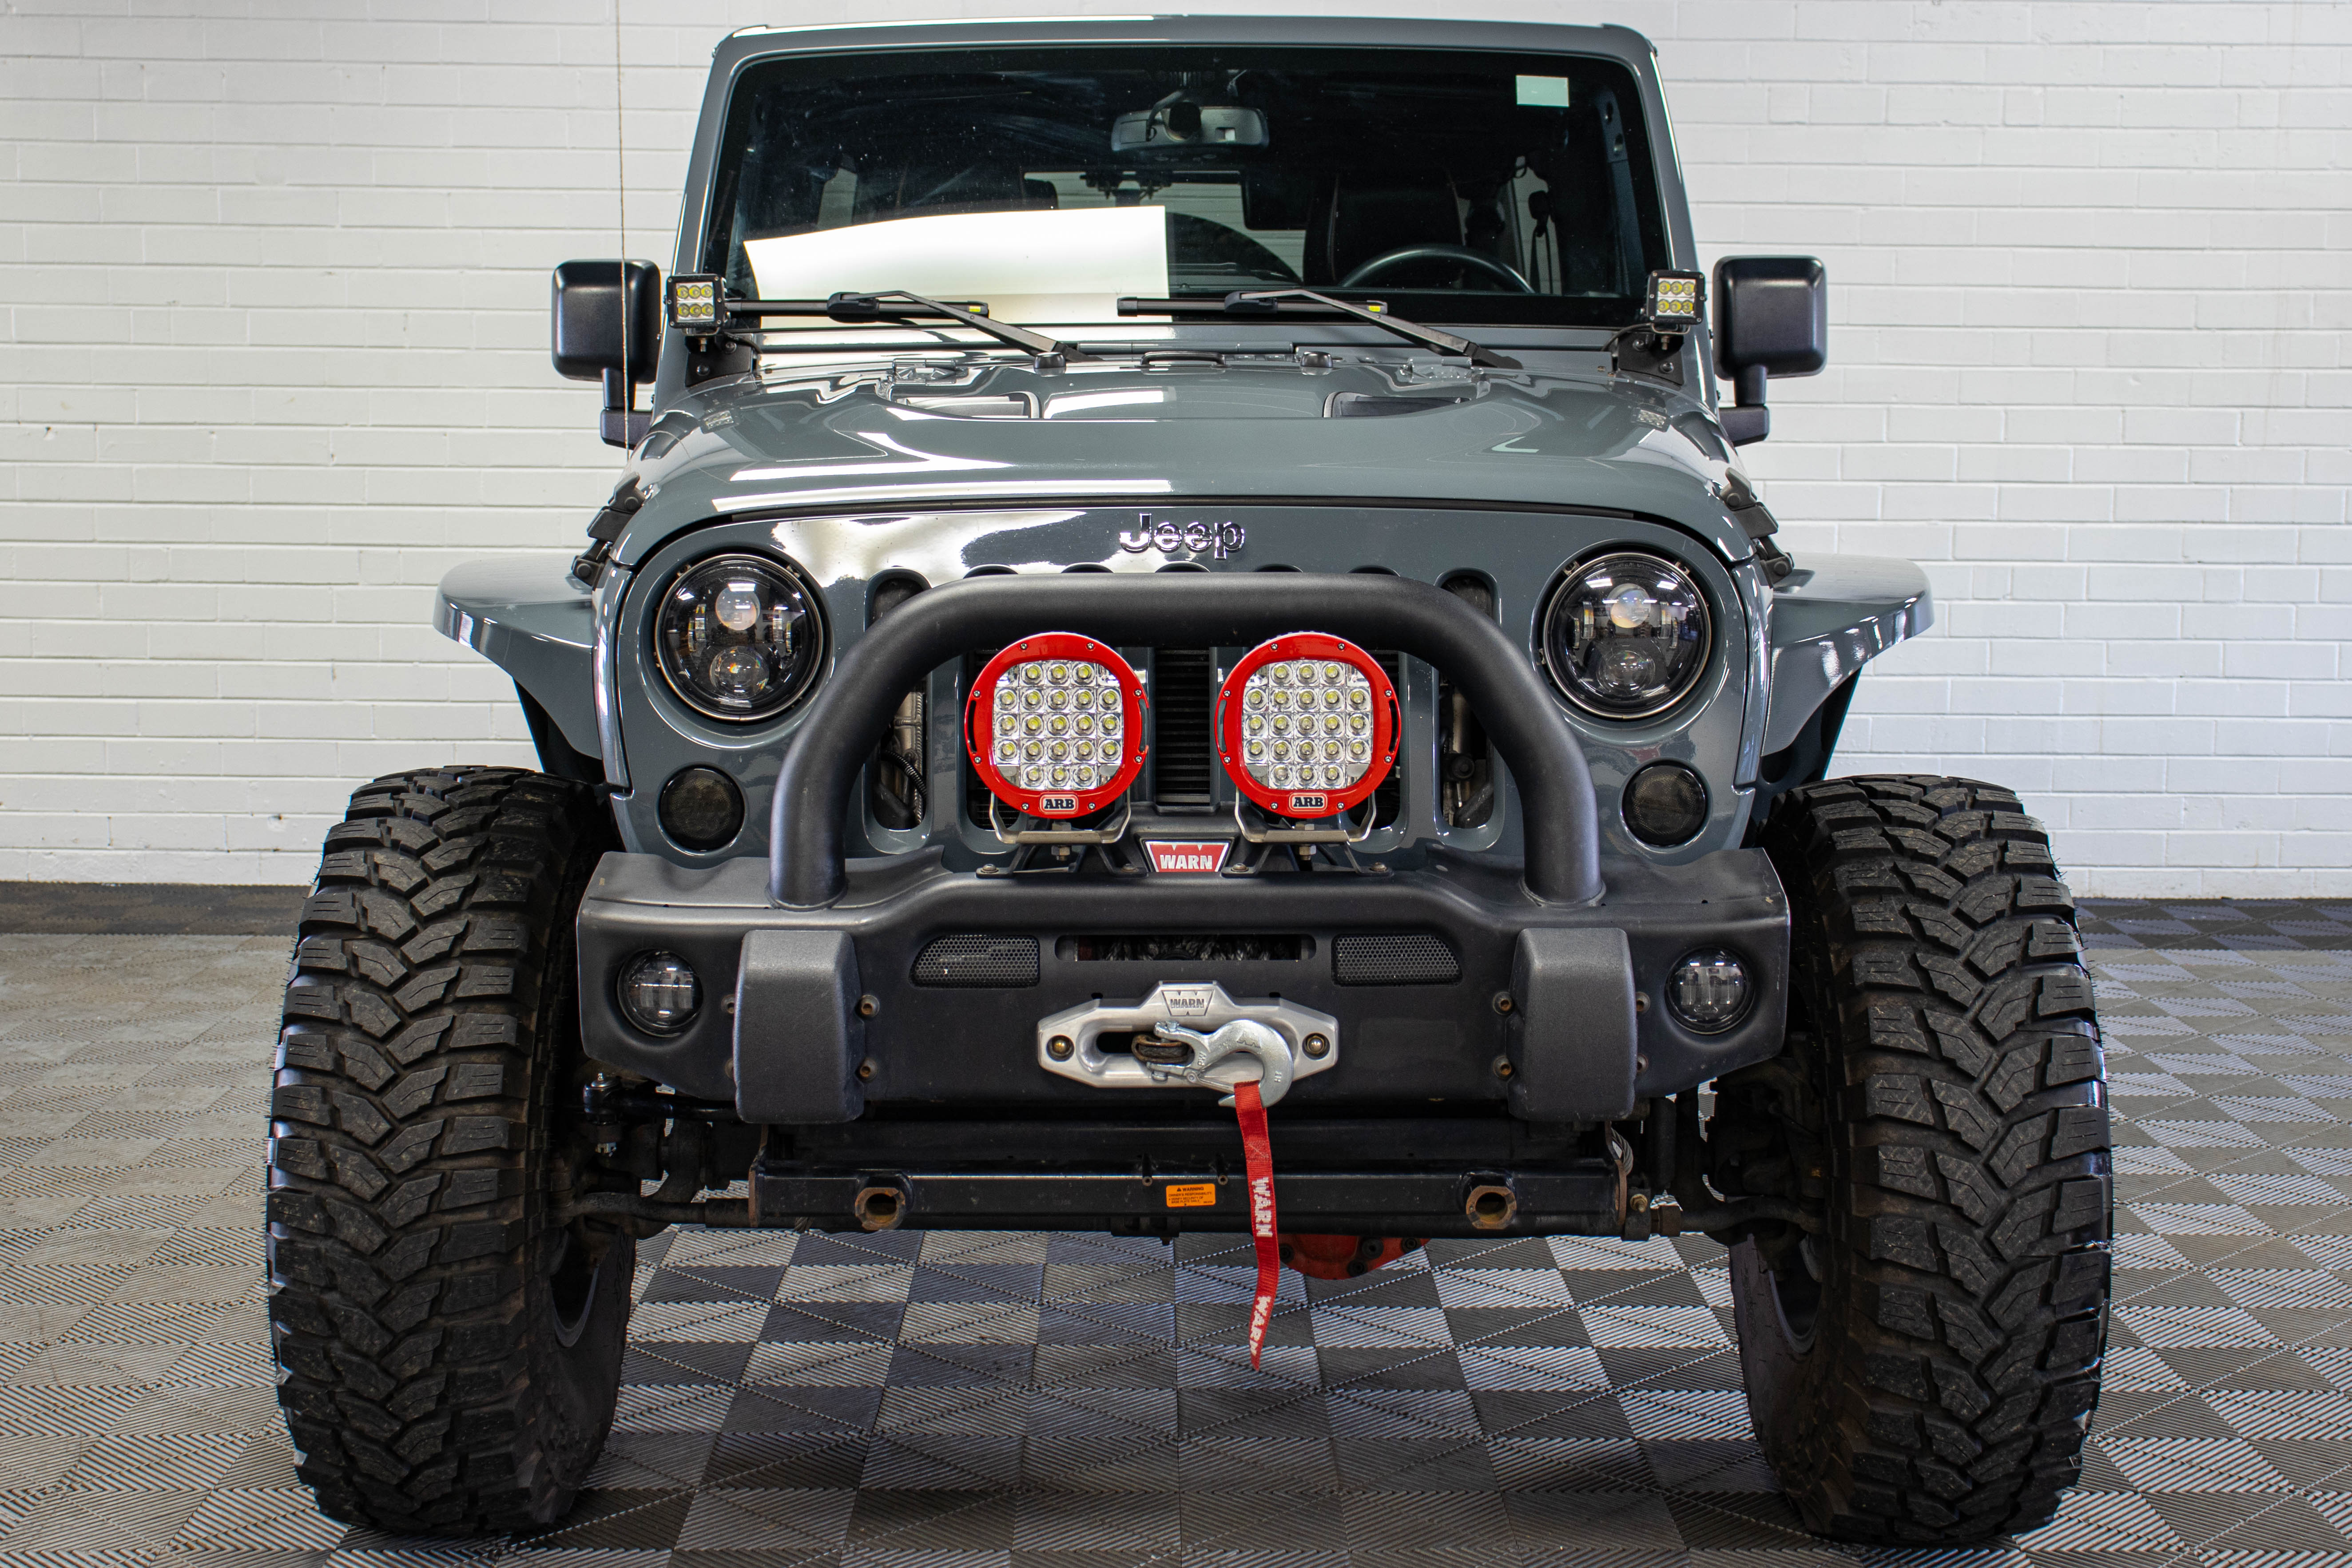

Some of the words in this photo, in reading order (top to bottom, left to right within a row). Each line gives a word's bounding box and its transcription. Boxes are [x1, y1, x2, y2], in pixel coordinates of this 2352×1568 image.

[1120, 512, 1245, 560] Jeep
[1044, 798, 1075, 809] ARB
[1293, 797, 1324, 807] ARB
[1160, 854, 1212, 869] WARN
[1170, 998, 1204, 1008] WARN
[1251, 1177, 1273, 1237] WARN
[1250, 1296, 1271, 1356] WARN
